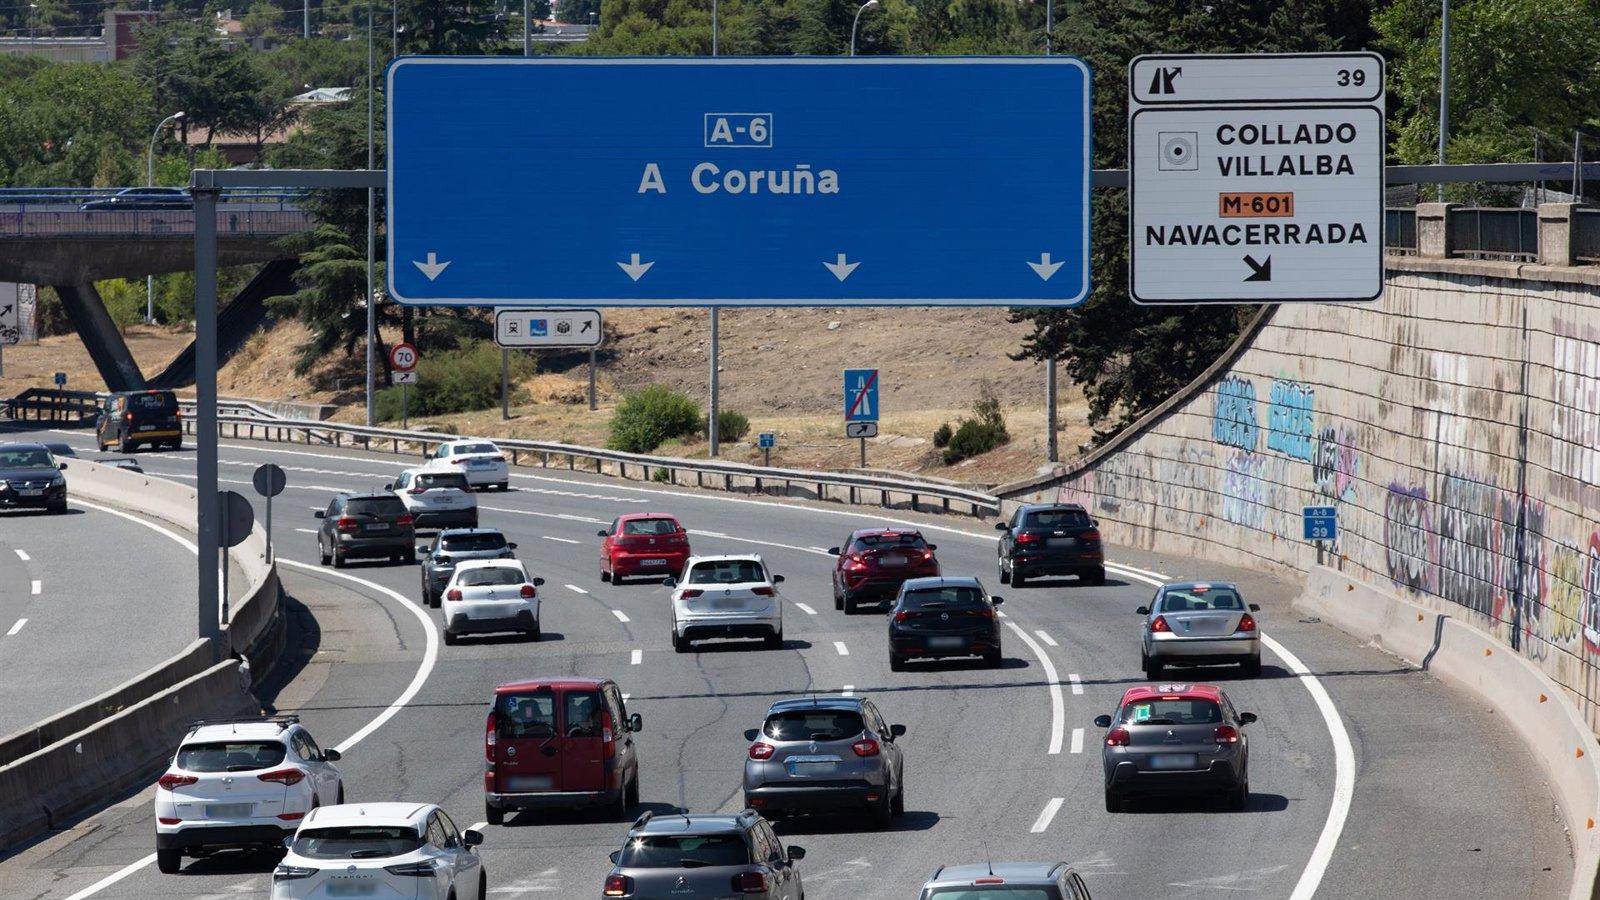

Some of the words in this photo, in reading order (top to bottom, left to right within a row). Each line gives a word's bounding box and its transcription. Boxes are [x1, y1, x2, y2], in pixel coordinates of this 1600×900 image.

[1338, 69, 1366, 87] 39
[710, 117, 768, 143] A-6
[1216, 122, 1357, 146] COLLADO
[1217, 154, 1355, 177] VILLALBA
[637, 163, 667, 194] A
[691, 162, 840, 195] Coruña
[1223, 196, 1290, 214] M-601
[1146, 222, 1368, 246] NAVACERRADA
[398, 352, 413, 362] 70
[1312, 527, 1328, 537] 39
